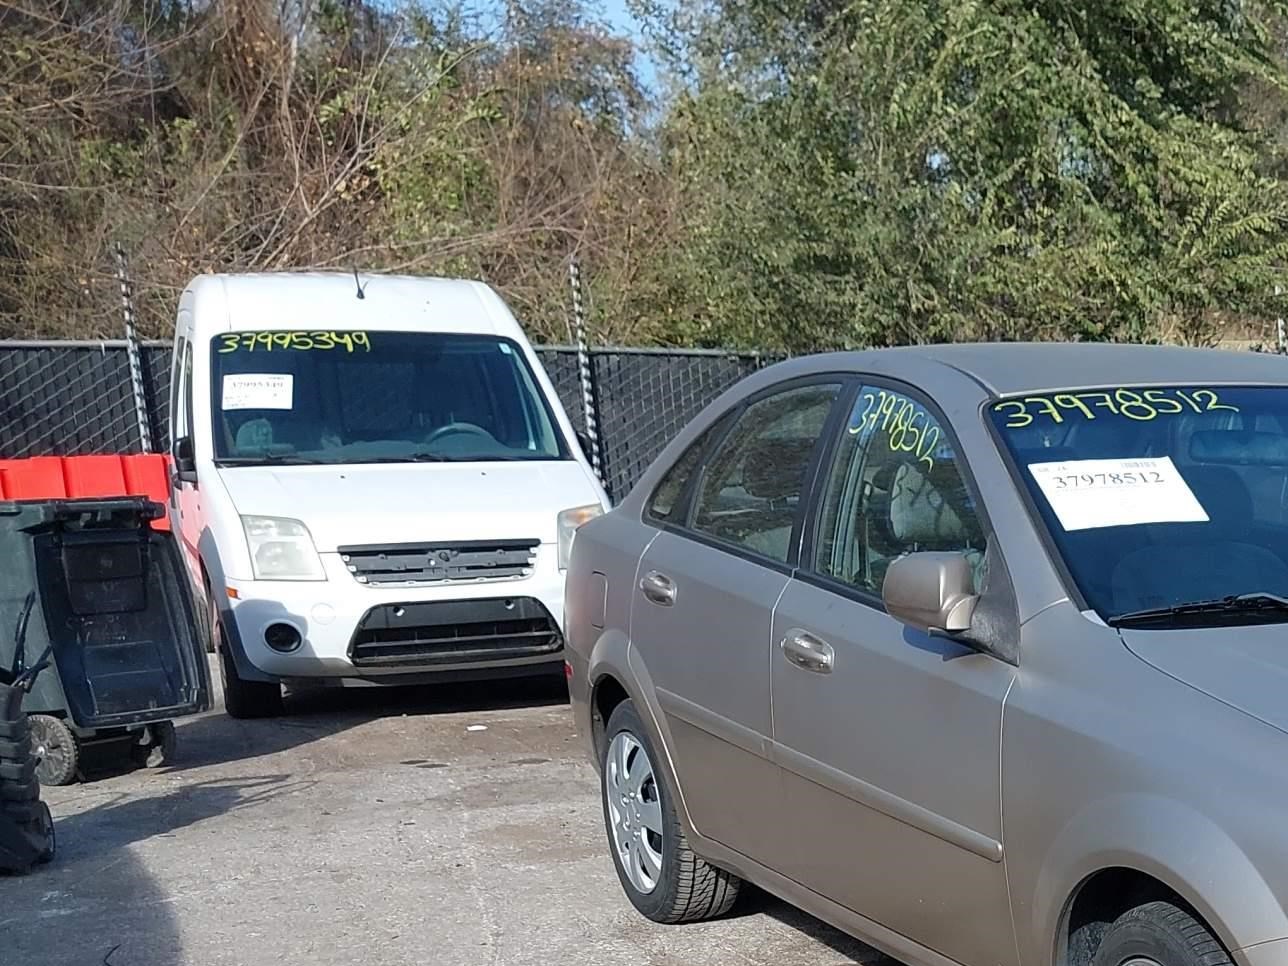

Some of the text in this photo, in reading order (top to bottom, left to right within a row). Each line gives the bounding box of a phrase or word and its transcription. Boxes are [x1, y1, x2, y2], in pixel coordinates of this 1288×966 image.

[218, 331, 371, 353] 37995349
[995, 388, 1240, 428] 37978512
[848, 391, 940, 473] 37978512
[1052, 471, 1165, 489] 37978512
